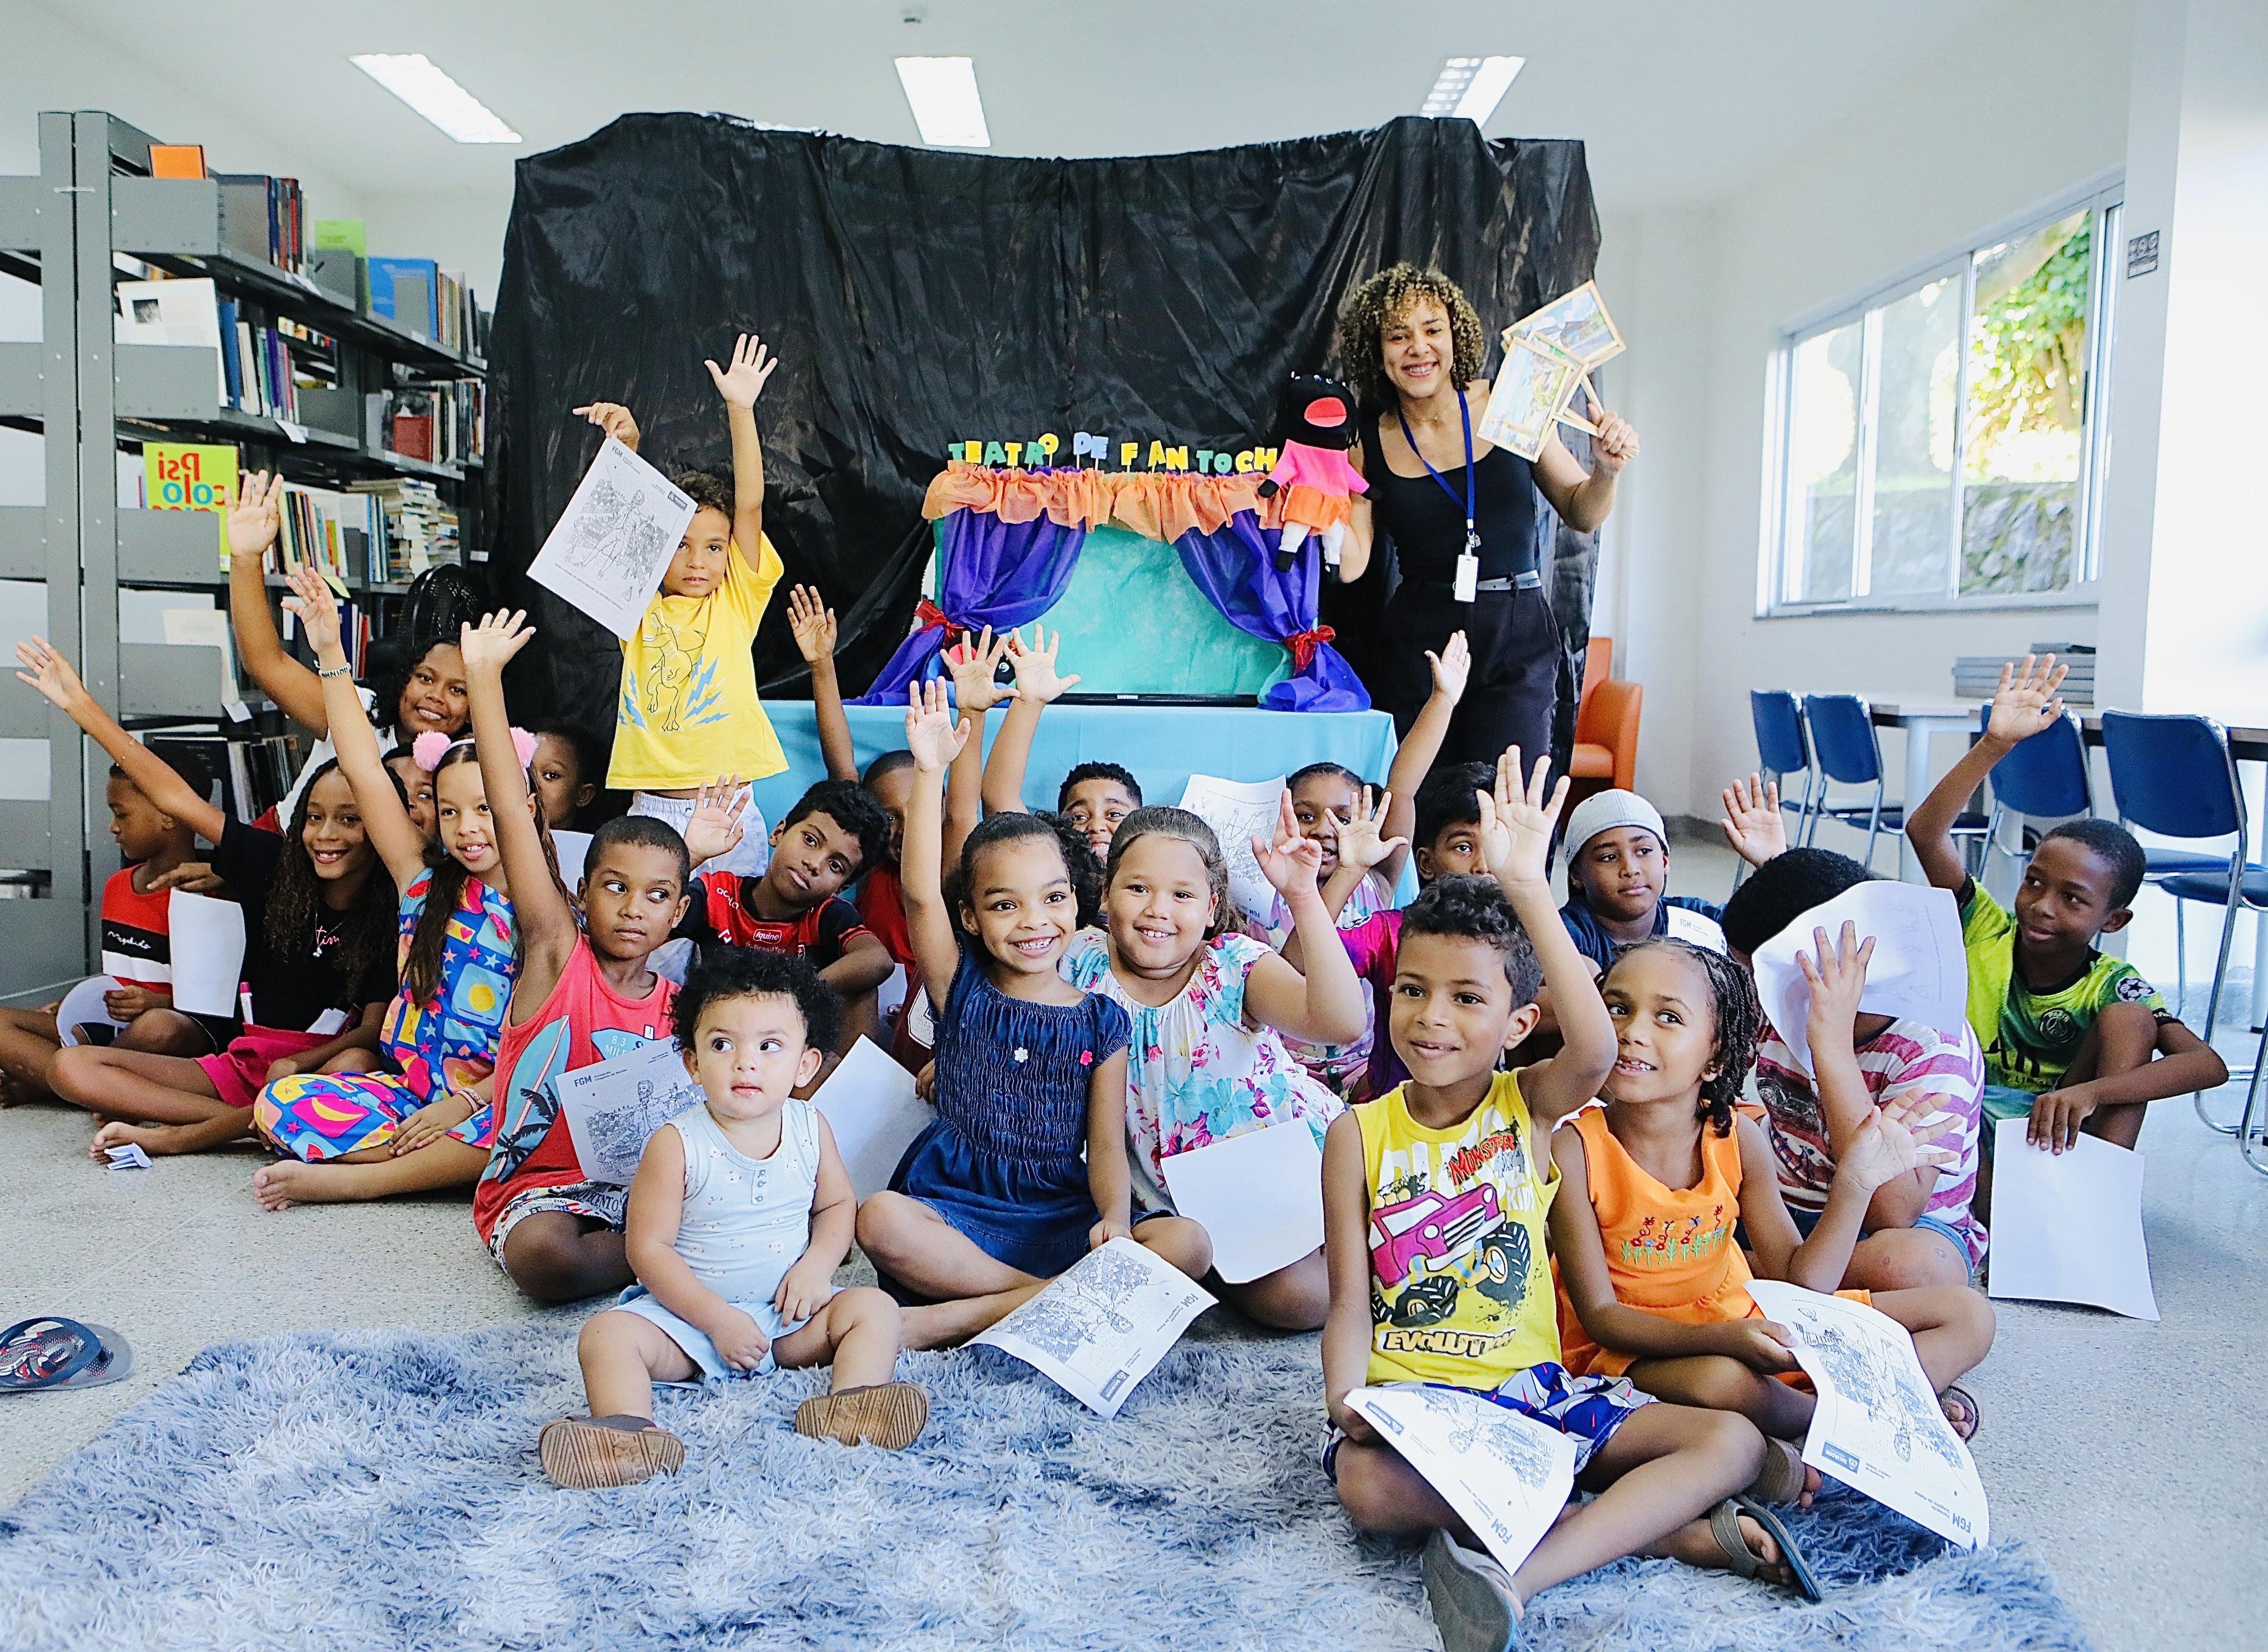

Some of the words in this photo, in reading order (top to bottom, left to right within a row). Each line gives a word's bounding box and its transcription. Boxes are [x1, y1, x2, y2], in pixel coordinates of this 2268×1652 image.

[611, 445, 623, 457] FGM
[948, 434, 1059, 465] TEATRO
[1073, 432, 1108, 459] DE
[1248, 908, 1260, 918] FGM
[1680, 918, 1691, 929] FGM
[755, 931, 780, 941] Iquine
[611, 1035, 627, 1047] 8.3
[573, 1075, 592, 1087] FGM
[1448, 1134, 1516, 1186] MONSTER
[1180, 1292, 1199, 1308] FGM
[1825, 1449, 1848, 1464] SALVADOR
[1951, 1512, 1972, 1533] FGM
[1489, 1518, 1513, 1545] FGM
